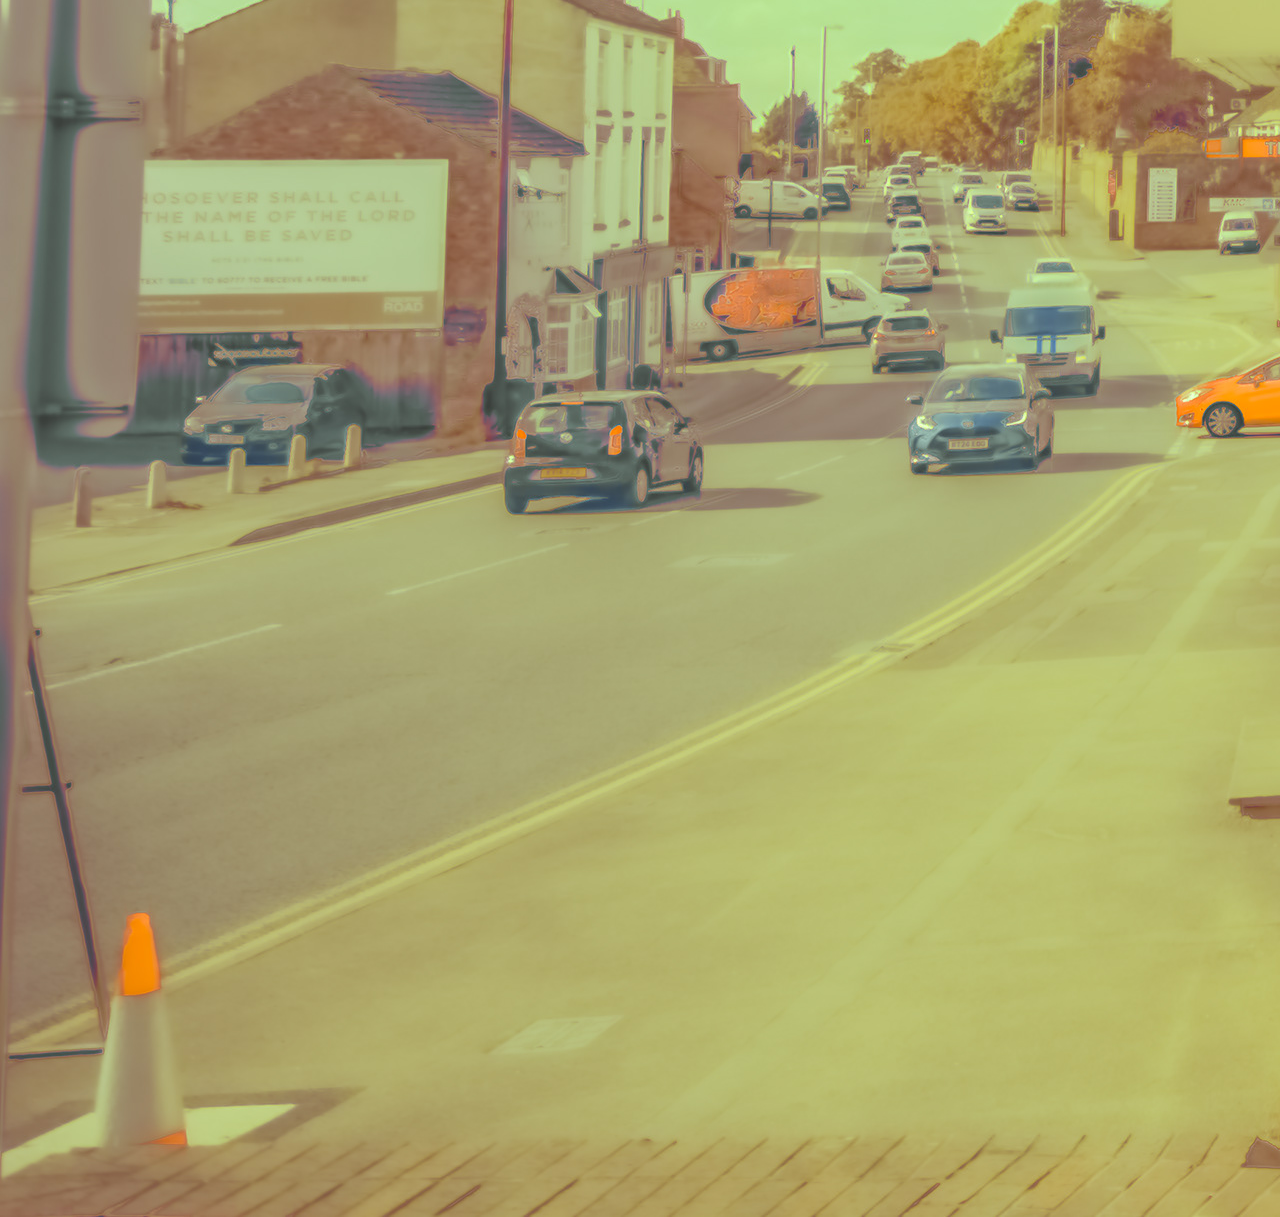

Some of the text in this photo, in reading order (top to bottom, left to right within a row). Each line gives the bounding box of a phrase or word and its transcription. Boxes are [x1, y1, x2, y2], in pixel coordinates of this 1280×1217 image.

[142, 191, 405, 205] HOSOEVER SHALL CALL
[142, 209, 416, 224] THE NAME OF THE LORD
[162, 229, 353, 244] SHALL BE SAVED
[202, 277, 214, 285] TO
[263, 276, 303, 284] RECEIVE
[384, 302, 424, 313] ROAD
